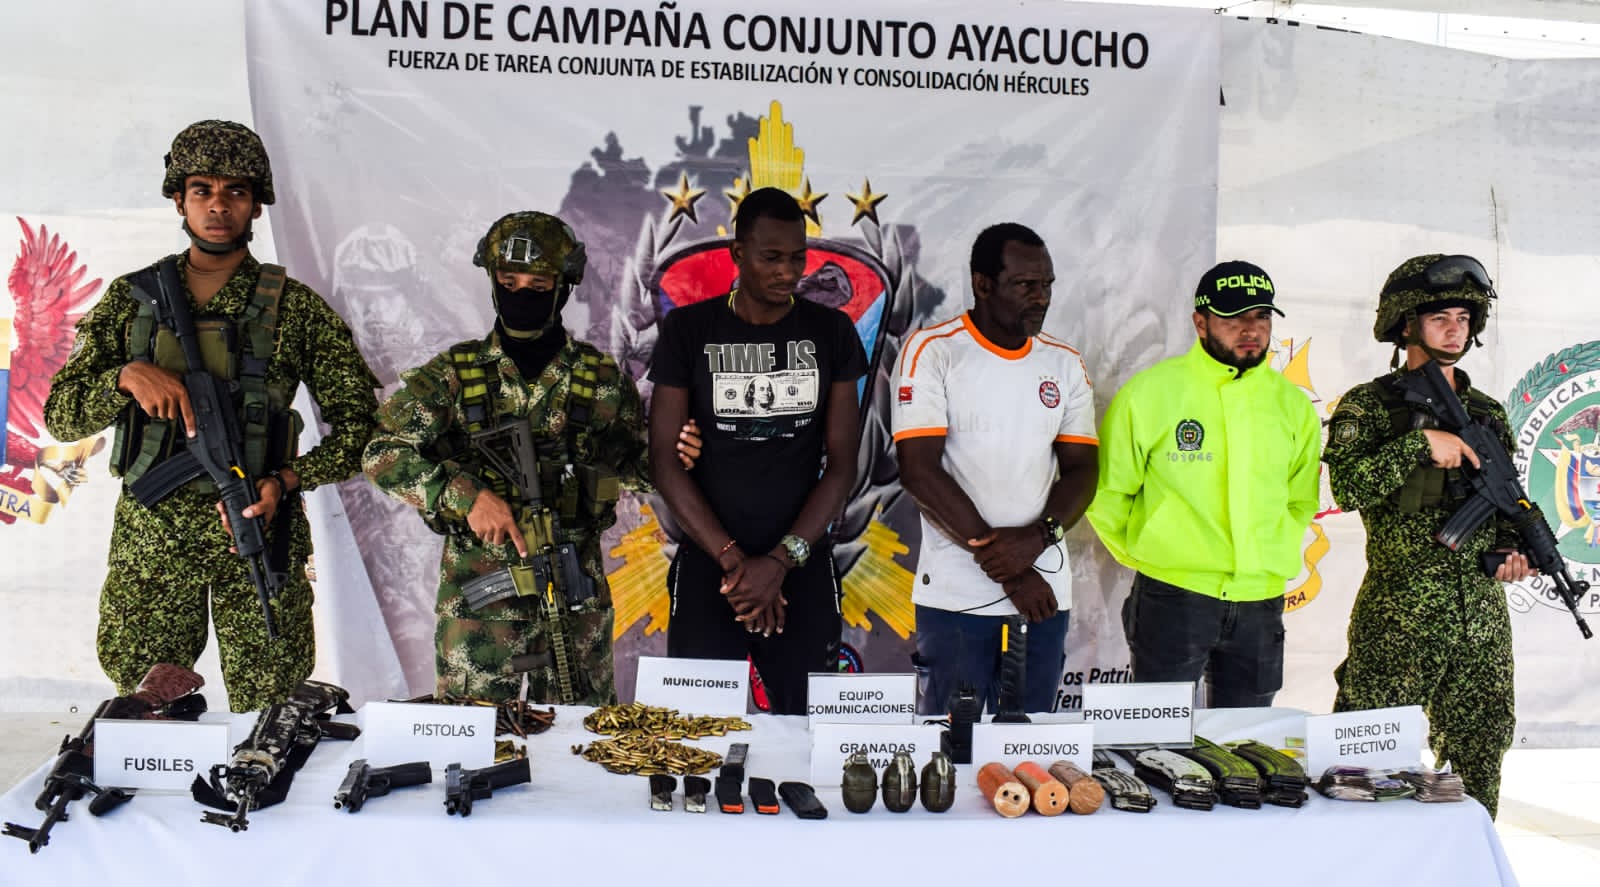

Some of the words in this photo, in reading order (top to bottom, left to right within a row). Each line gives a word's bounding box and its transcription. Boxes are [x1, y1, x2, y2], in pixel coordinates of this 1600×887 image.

[326, 0, 428, 39] PLAN
[443, 2, 494, 41] DE
[507, 1, 711, 50] CAMPAÑA
[723, 13, 937, 60] CONJUNTO
[947, 23, 1149, 70] AYACUCHO
[388, 49, 460, 71] FUERZA
[465, 52, 490, 72] DE
[494, 53, 553, 74] TAREA
[557, 55, 656, 78] CONJUNTA
[661, 59, 685, 79] DE
[690, 60, 833, 85] ESTABILIZACIÓN
[837, 67, 849, 85] Y
[853, 68, 999, 92] CONSOLIDACIÓN
[1004, 70, 1089, 96] HÉRCULES
[1216, 275, 1273, 294] POLICÍA
[704, 343, 776, 373] TIME
[787, 340, 817, 370] IS
[1516, 381, 1584, 489] EPÚBLICA
[1530, 575, 1565, 604] DIO
[1286, 591, 1306, 608] RA
[662, 676, 740, 690] MUNICIONES
[1063, 671, 1084, 686] os
[839, 690, 884, 703] EQUIPO
[808, 703, 915, 716] COMUNICACIONES
[1083, 706, 1190, 721] PROVEEDORES
[412, 723, 476, 738] PISTOLAS
[1335, 726, 1381, 740] DINERO
[1384, 723, 1401, 736] EN
[839, 743, 916, 754] GRANADAS
[1003, 743, 1079, 756] EXPLOSIVOS
[1339, 739, 1397, 757] EFECTIVO
[123, 757, 194, 773] FUSILES
[870, 758, 891, 769] MA
